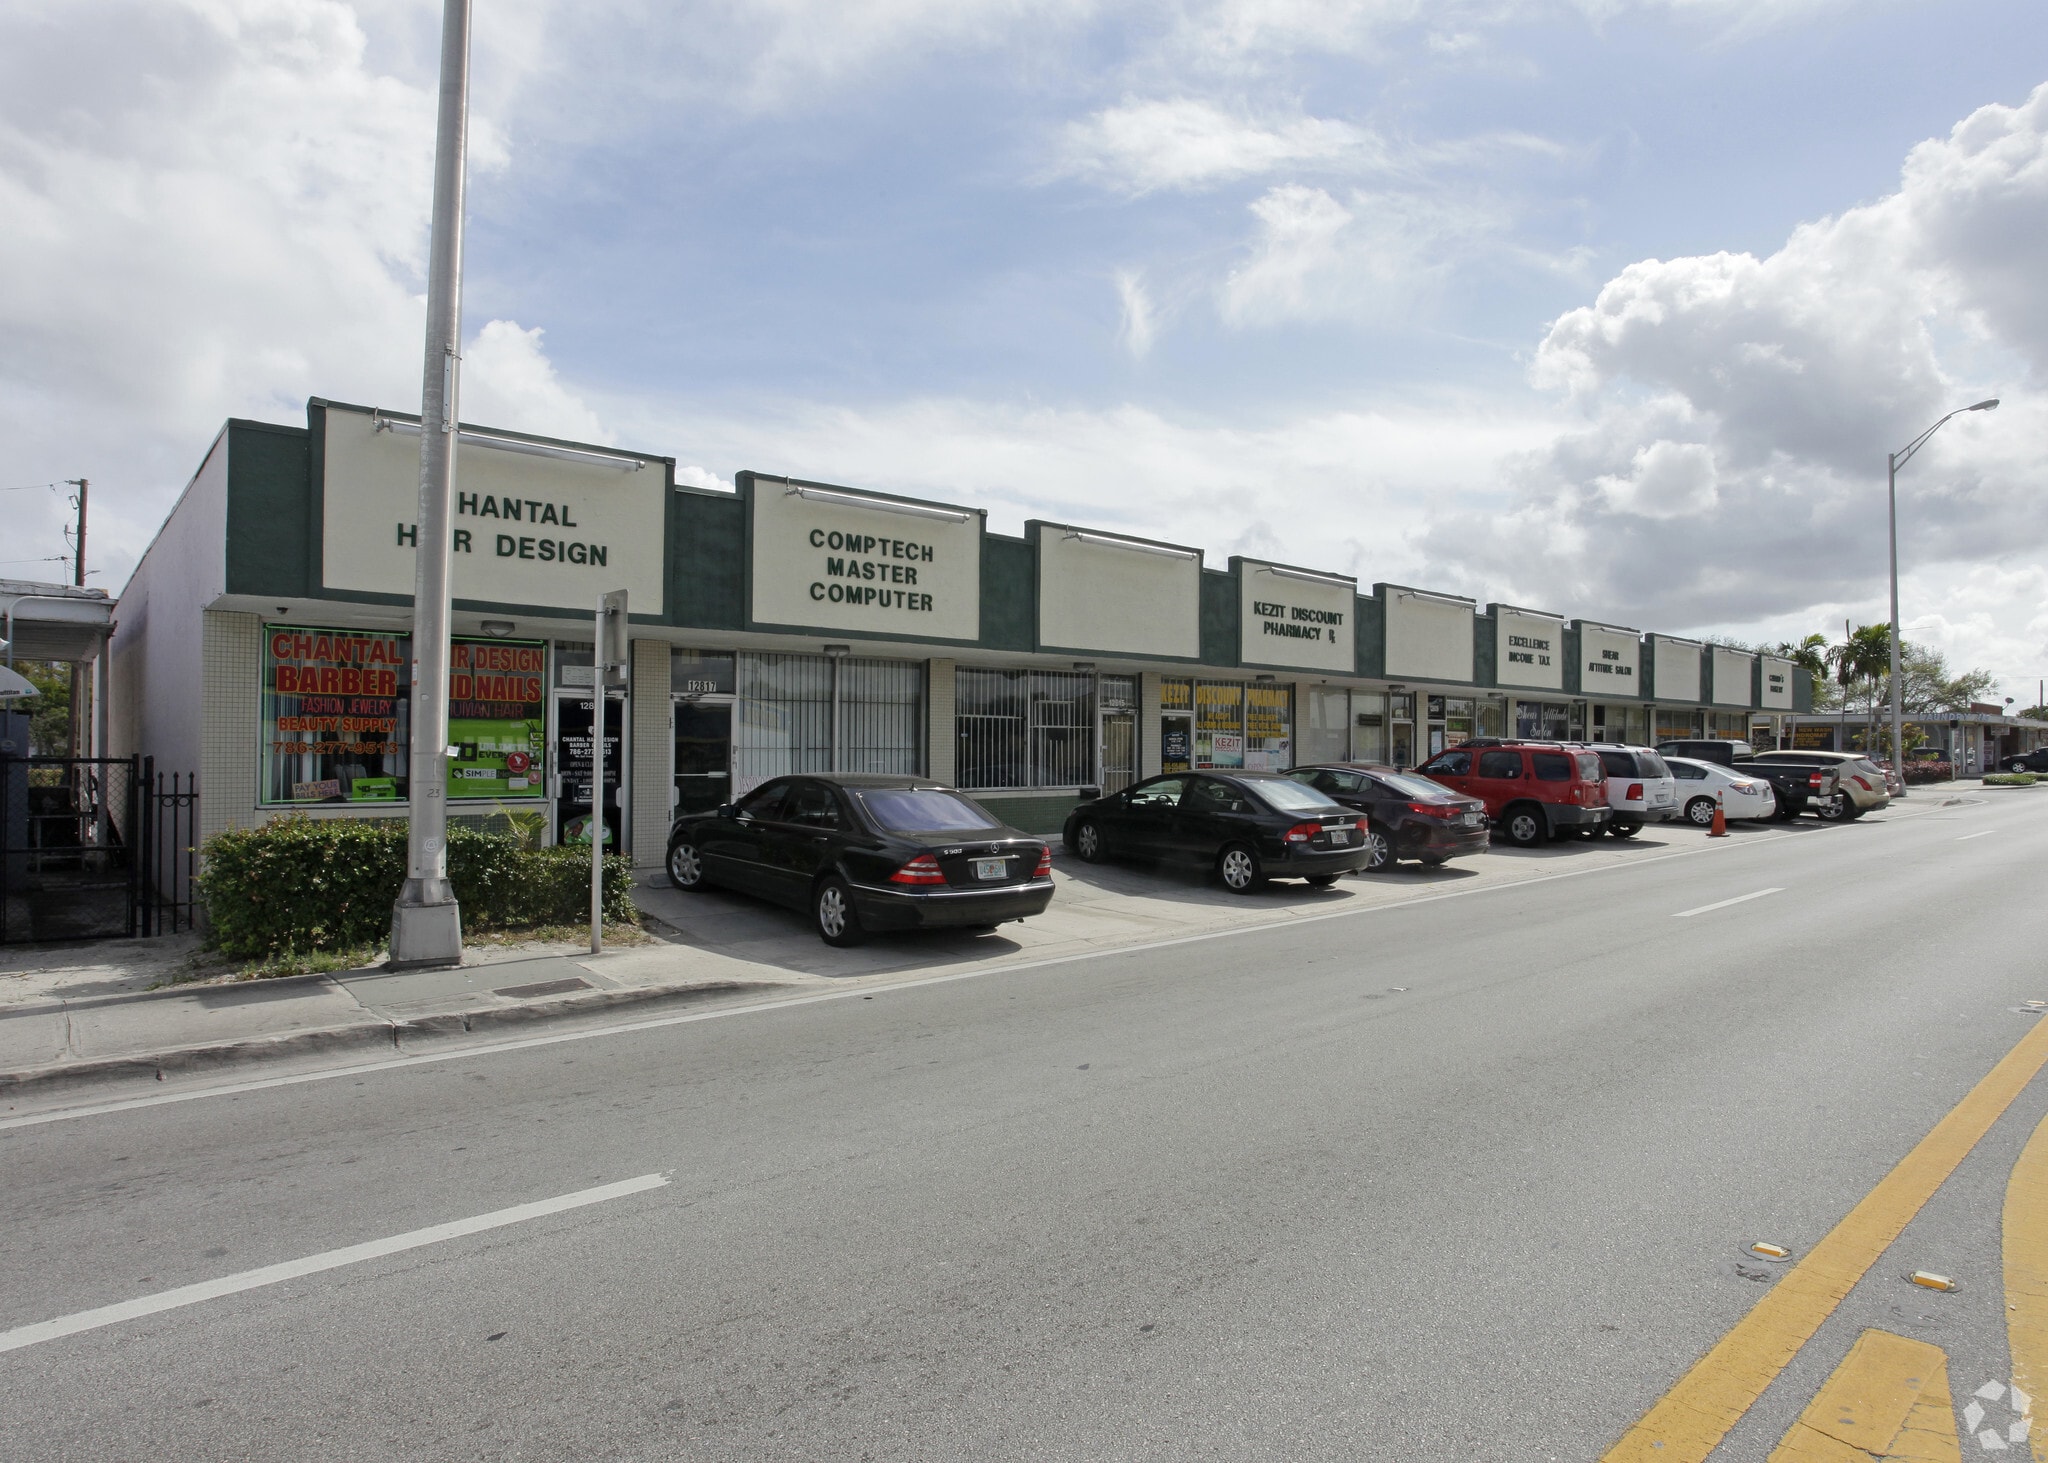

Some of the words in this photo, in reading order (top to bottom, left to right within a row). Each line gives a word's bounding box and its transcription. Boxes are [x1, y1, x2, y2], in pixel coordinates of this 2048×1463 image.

[458, 491, 577, 528] HANTAL
[397, 523, 472, 553] HR
[496, 534, 608, 567] DESIGN
[809, 529, 934, 562] COMPTECH
[827, 557, 918, 585] MASTER
[809, 582, 934, 611] COMPUTER
[1253, 601, 1286, 618] KEZIT
[1292, 607, 1344, 626] DISCOUNT
[1263, 621, 1322, 640] PHARMACY
[271, 634, 404, 665] CHANTAL
[1508, 635, 1550, 651] EXCELLENCE
[474, 645, 544, 673] DESIGN
[1508, 651, 1534, 664] INCOME
[1538, 654, 1551, 666] TAX
[276, 664, 397, 696] BARBER
[475, 674, 542, 703] NAILS
[689, 680, 716, 692] 12817
[1160, 684, 1190, 704] KEZIT
[301, 697, 344, 714] FASHION
[348, 698, 392, 715] JEWELRY
[580, 702, 595, 710] 128
[278, 716, 338, 732] BEAUTY
[342, 717, 398, 733] SUPPLY
[272, 741, 399, 755] 786-277-9513
[1215, 737, 1241, 747] KEZIT
[465, 769, 495, 778] SIMPLE
[294, 784, 311, 793] PAY
[313, 780, 338, 791] YOUR
